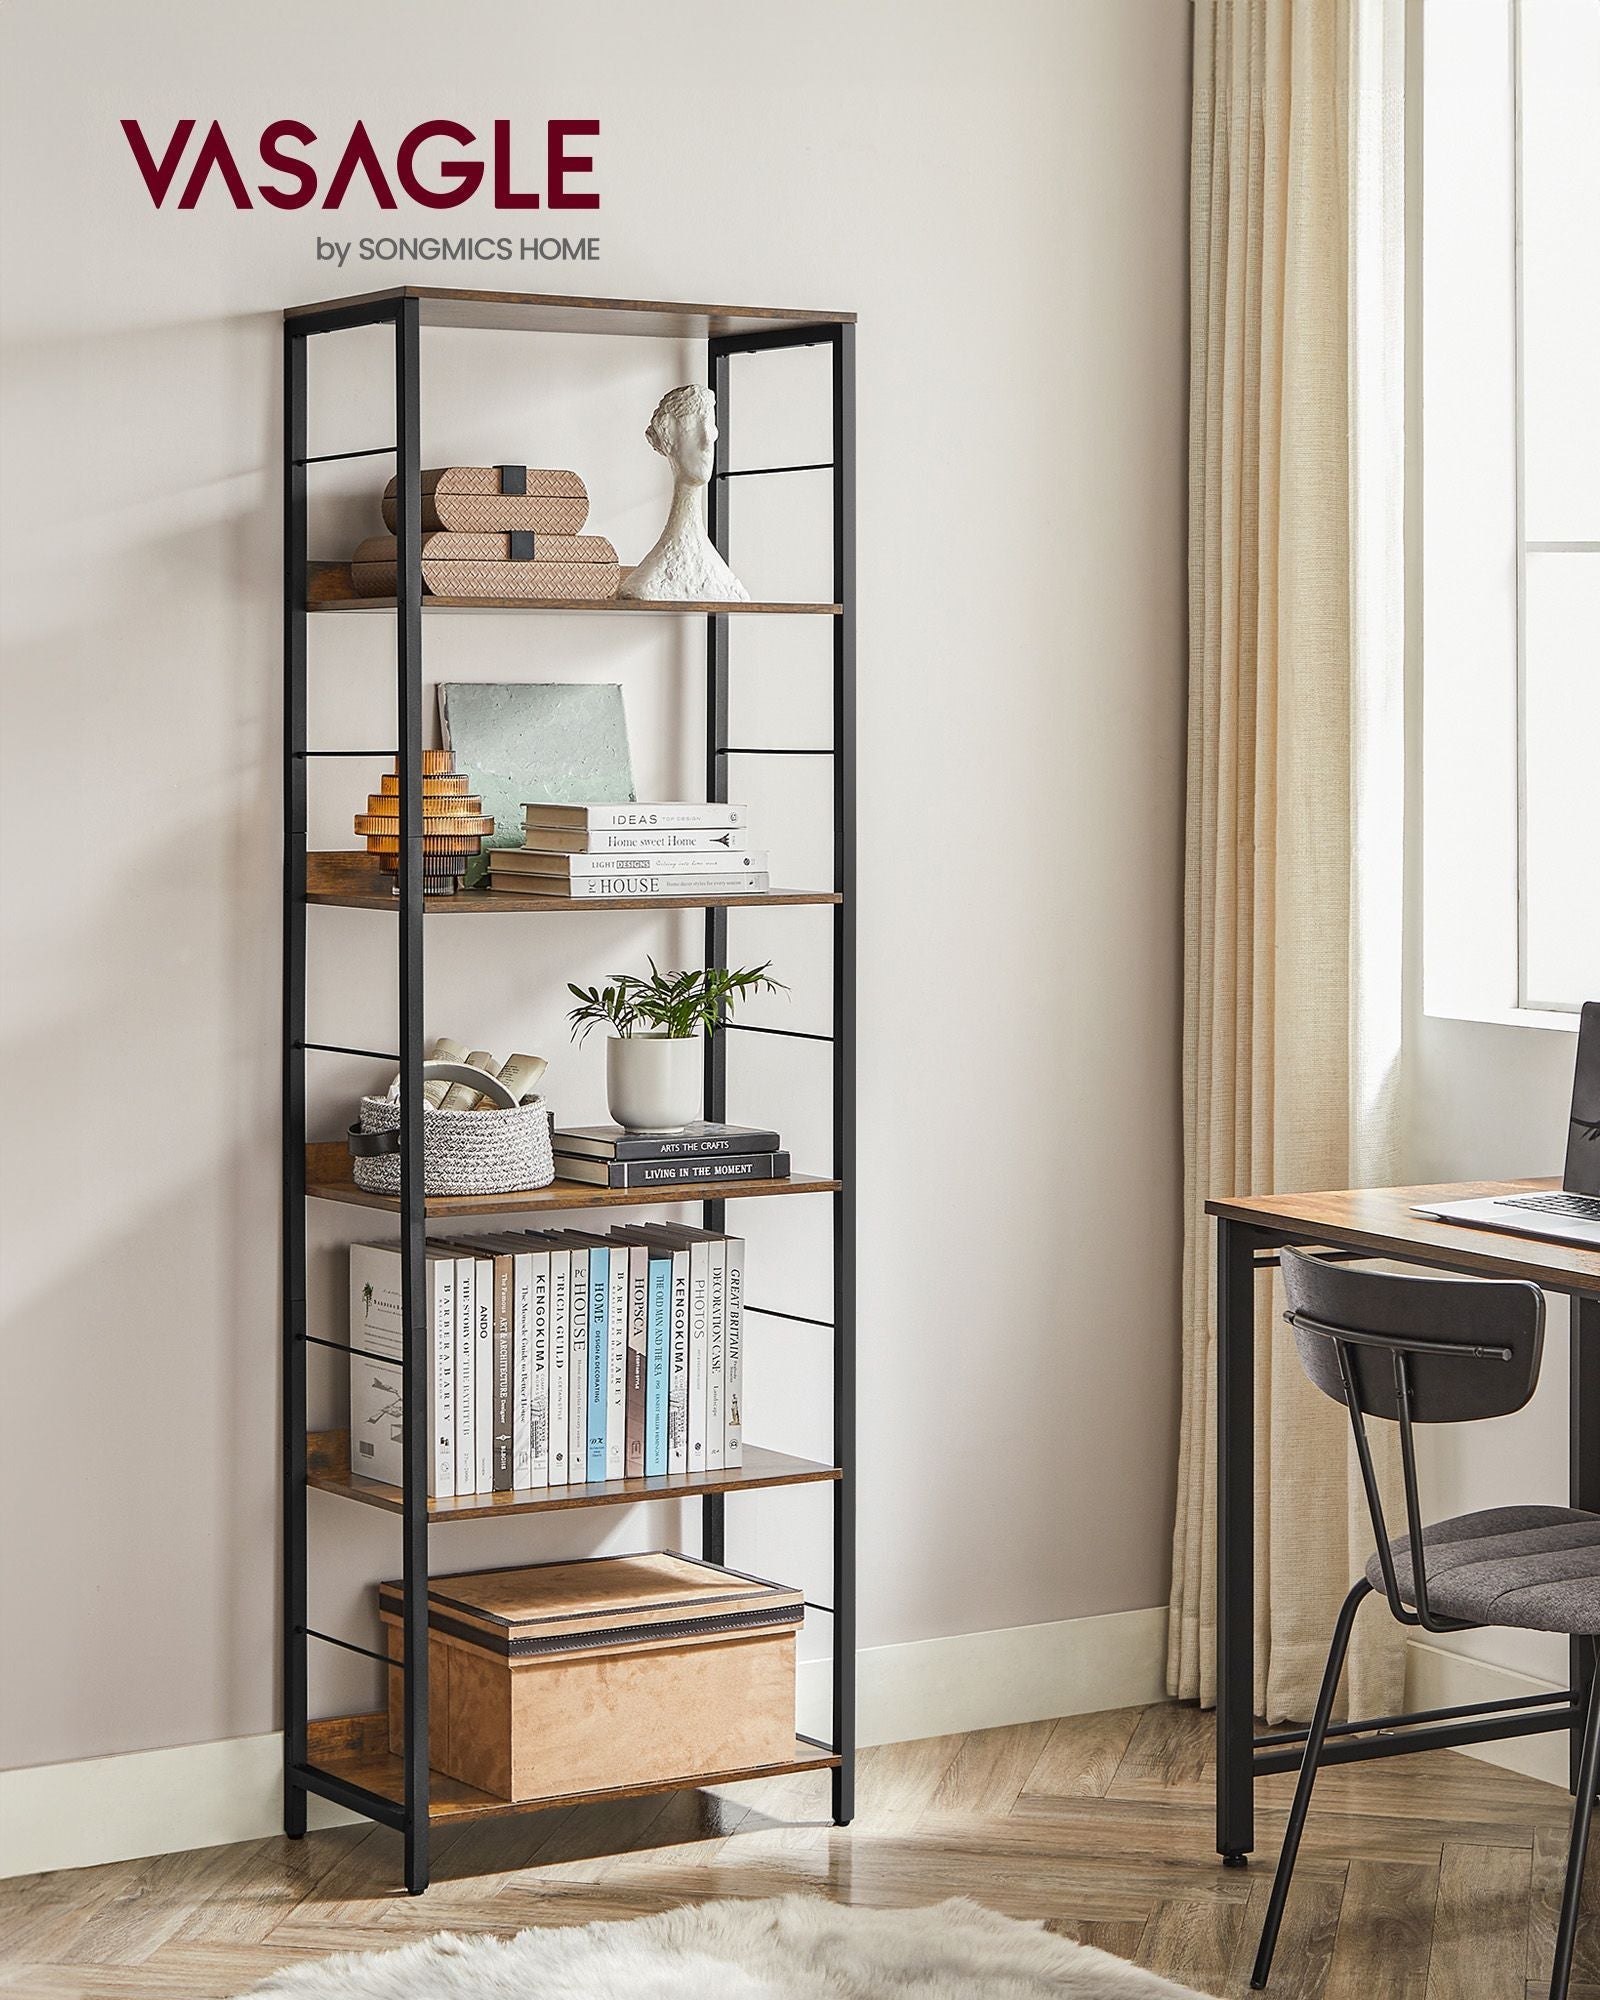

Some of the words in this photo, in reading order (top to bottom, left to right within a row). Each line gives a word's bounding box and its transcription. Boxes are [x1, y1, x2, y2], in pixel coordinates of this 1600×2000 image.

[612, 814, 658, 825] IDEAS
[608, 836, 638, 847] Home
[640, 838, 664, 847] sweet
[668, 836, 696, 846] Home
[616, 860, 650, 868] DESIGNS
[601, 878, 660, 894] HOUSE
[660, 1144, 680, 1153] ARTS
[682, 1143, 698, 1152] THE
[701, 1140, 730, 1150] CRAFTS
[645, 1169, 676, 1180] LIVING
[680, 1168, 689, 1177] IN
[692, 1166, 712, 1176] THE
[714, 1164, 753, 1175] MOMENT
[575, 1268, 586, 1278] PC
[656, 1274, 664, 1288] THE
[731, 1269, 740, 1308] GREAT
[557, 1273, 565, 1322] TRICIA
[594, 1283, 604, 1323] HOME
[656, 1291, 664, 1307] OLD
[712, 1267, 722, 1342] DECORATION
[633, 1278, 644, 1336] HOPSCA
[694, 1280, 705, 1339] PHOTOS
[536, 1275, 545, 1372] KENGOKUMA
[574, 1284, 586, 1352] HOUSE
[655, 1308, 664, 1326] MAN
[674, 1278, 685, 1373] KENGOKUMA
[655, 1328, 663, 1345] AND
[730, 1312, 739, 1360] BRITAIN
[463, 1342, 470, 1356] OF
[654, 1347, 662, 1361] THE
[654, 1363, 662, 1376] SEA
